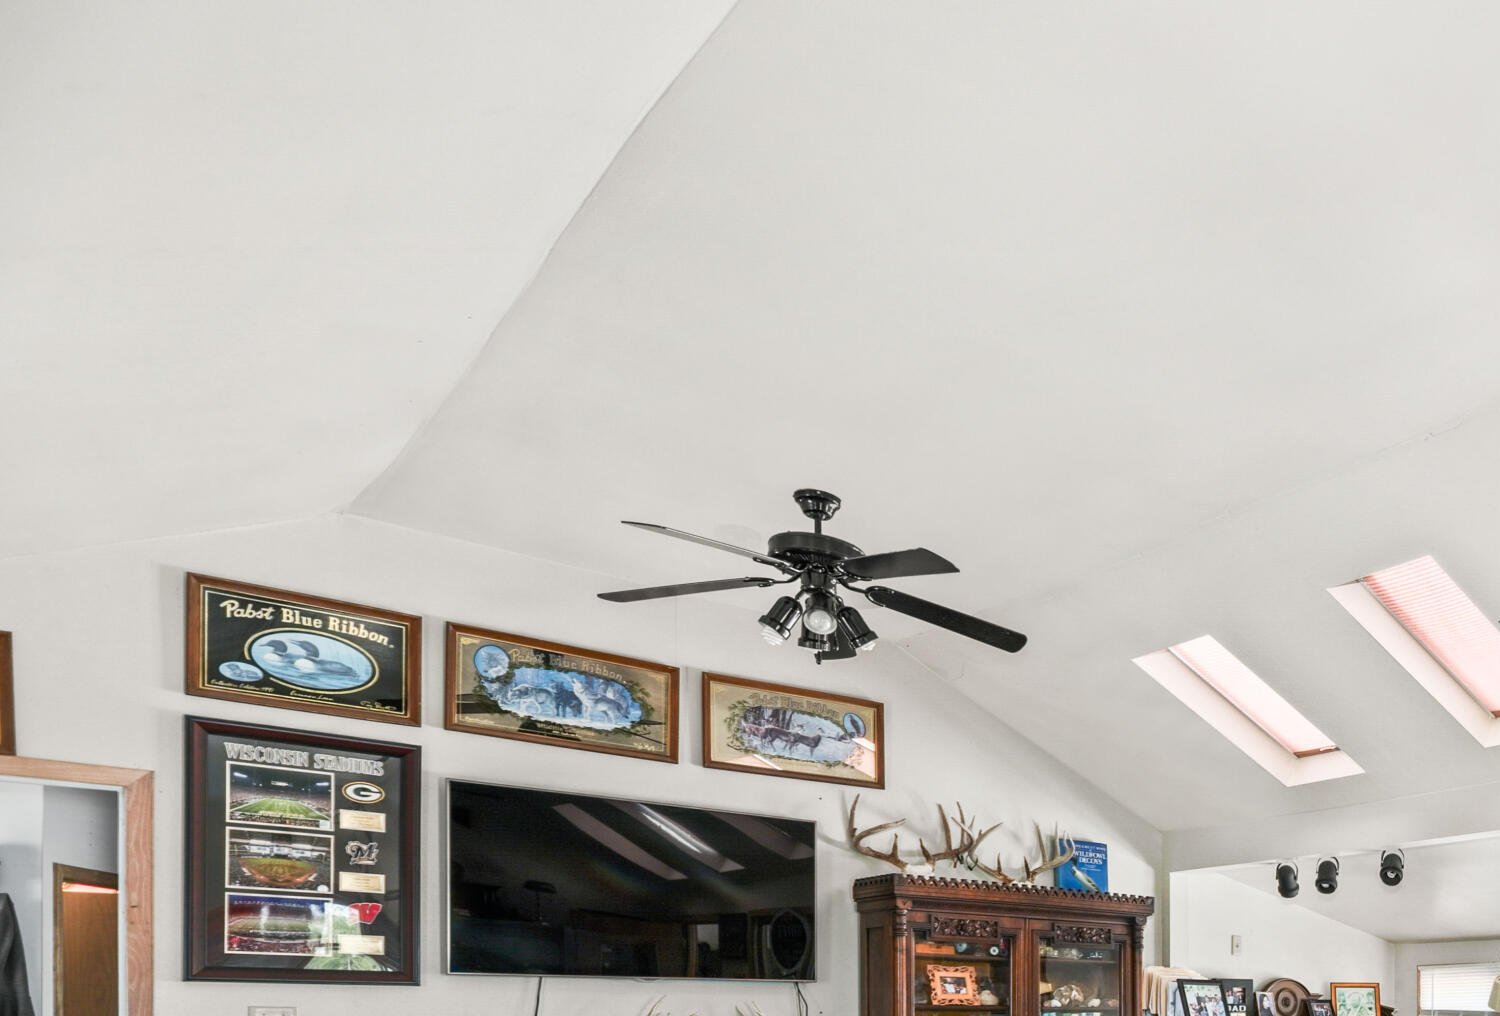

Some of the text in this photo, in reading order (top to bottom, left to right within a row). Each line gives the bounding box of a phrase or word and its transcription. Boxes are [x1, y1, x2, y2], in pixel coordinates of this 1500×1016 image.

[219, 599, 276, 620] Pabst
[280, 607, 323, 629] Blue
[223, 741, 385, 777] WISCONSIN STADIUMS
